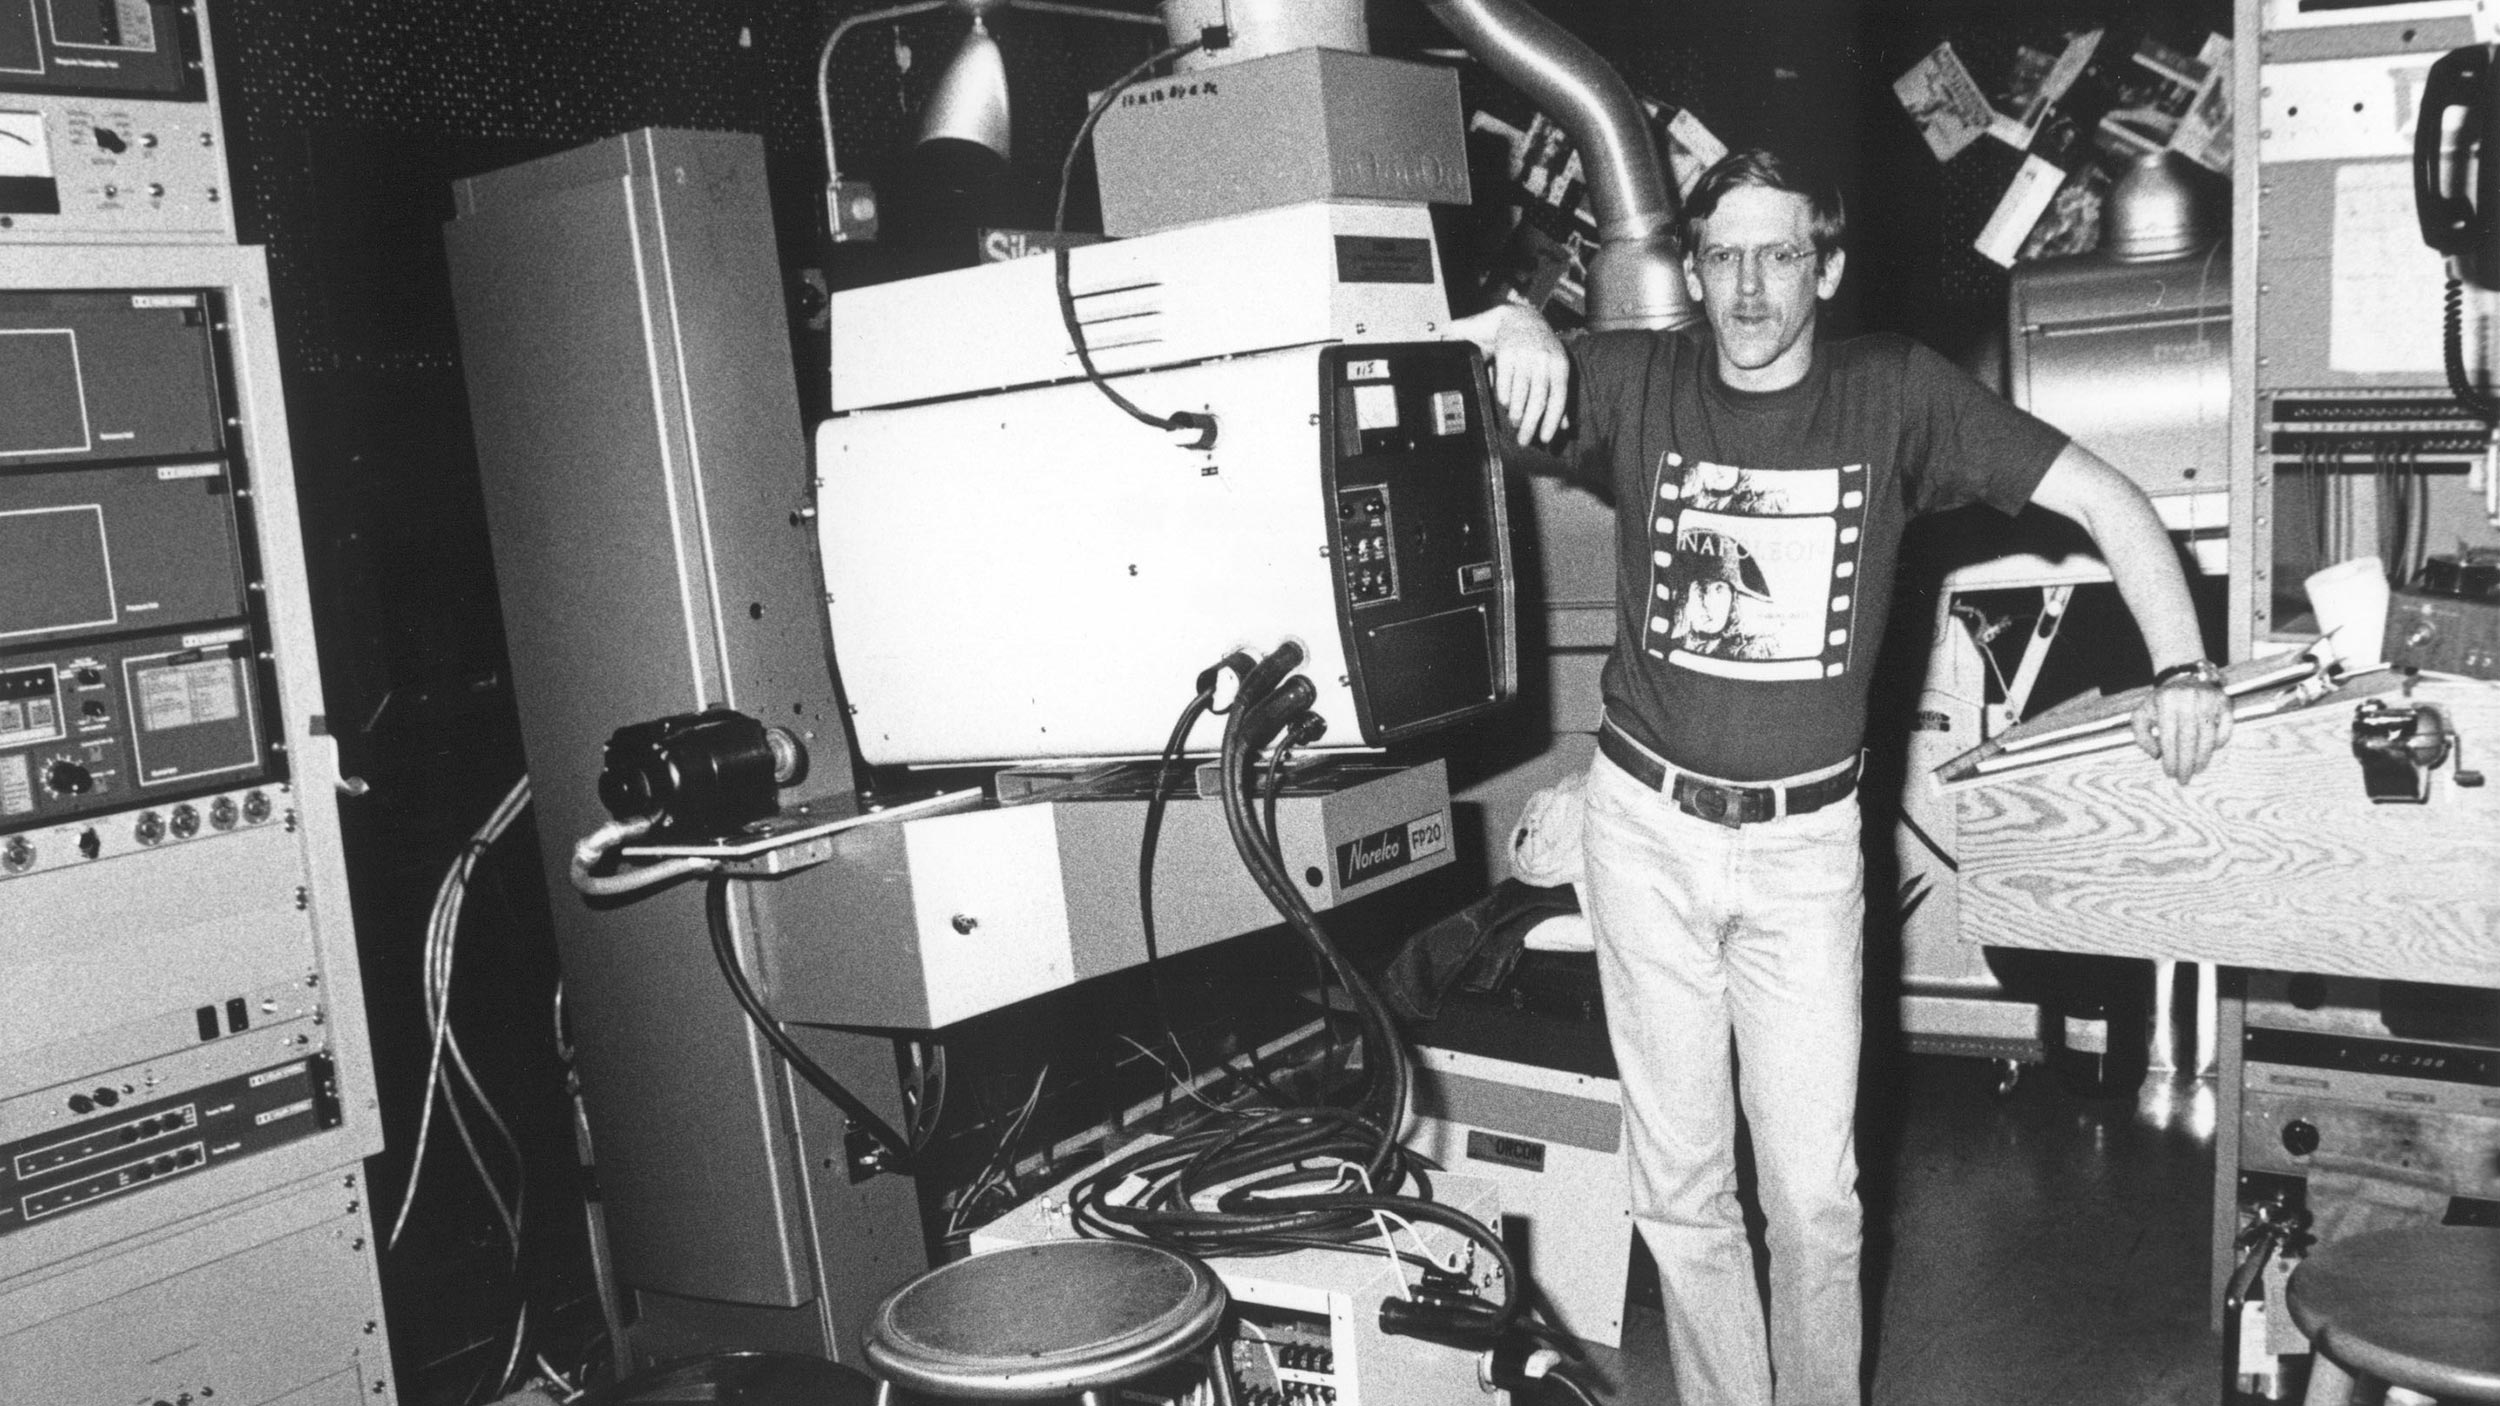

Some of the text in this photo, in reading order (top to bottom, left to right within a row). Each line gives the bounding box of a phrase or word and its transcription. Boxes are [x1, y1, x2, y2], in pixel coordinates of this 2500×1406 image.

[1681, 533, 1827, 561] NAPOLEON
[1348, 823, 1442, 880] Norelco FP20
